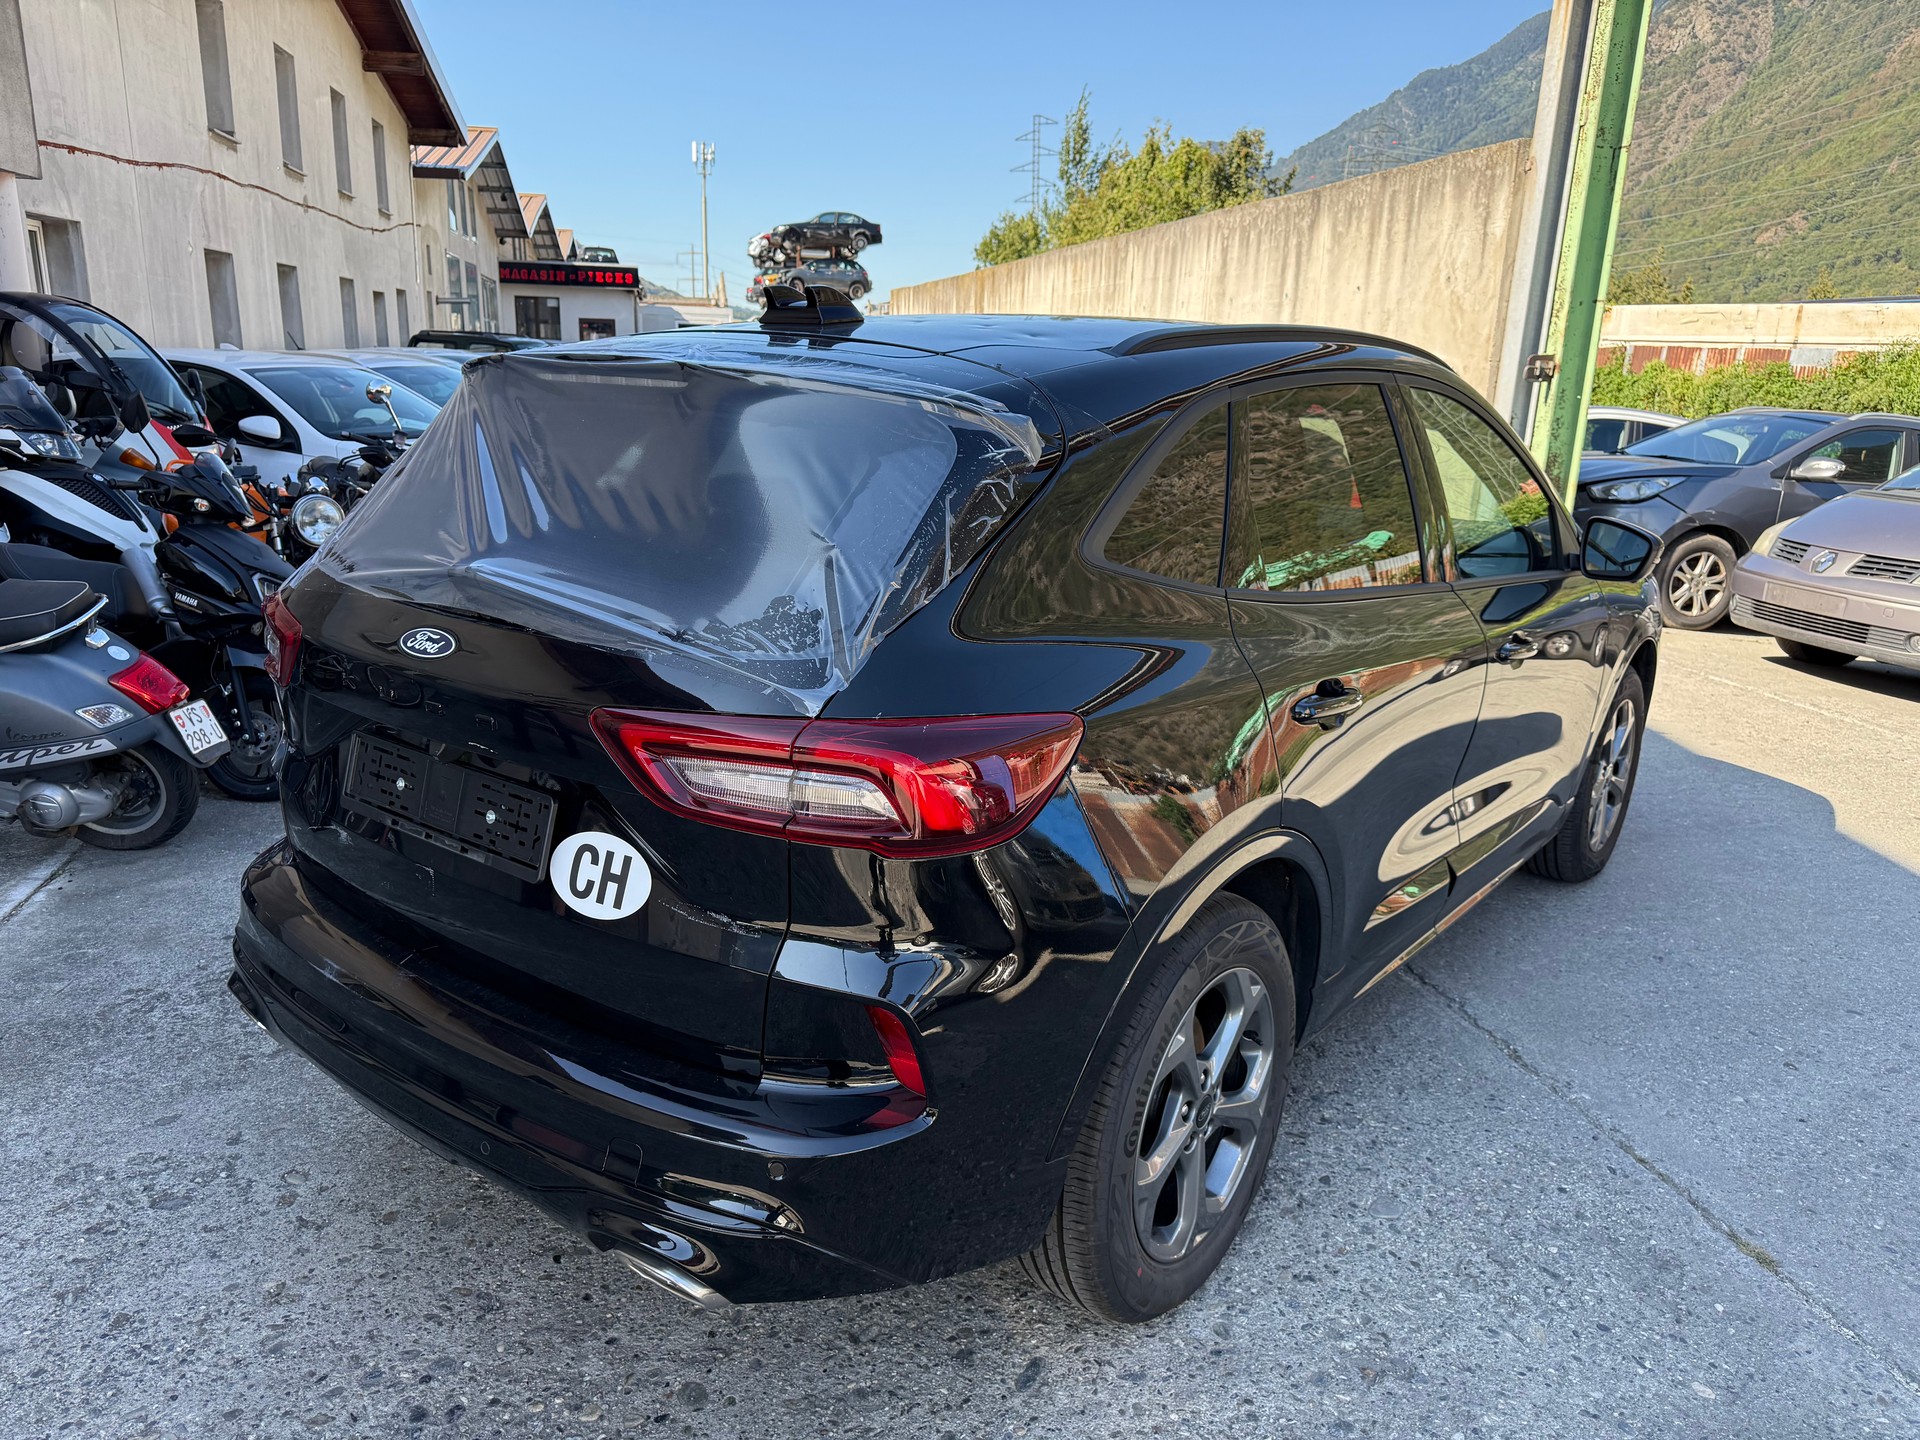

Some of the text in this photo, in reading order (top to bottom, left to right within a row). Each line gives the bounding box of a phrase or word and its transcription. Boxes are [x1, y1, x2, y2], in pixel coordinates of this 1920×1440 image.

[500, 267, 566, 282] MAGASIN
[174, 591, 199, 607] YAMAHA
[406, 630, 446, 654] Ford
[182, 706, 203, 727] VS
[0, 737, 103, 767] uper
[569, 843, 633, 911] CH
[1123, 997, 1185, 1158] Continental
